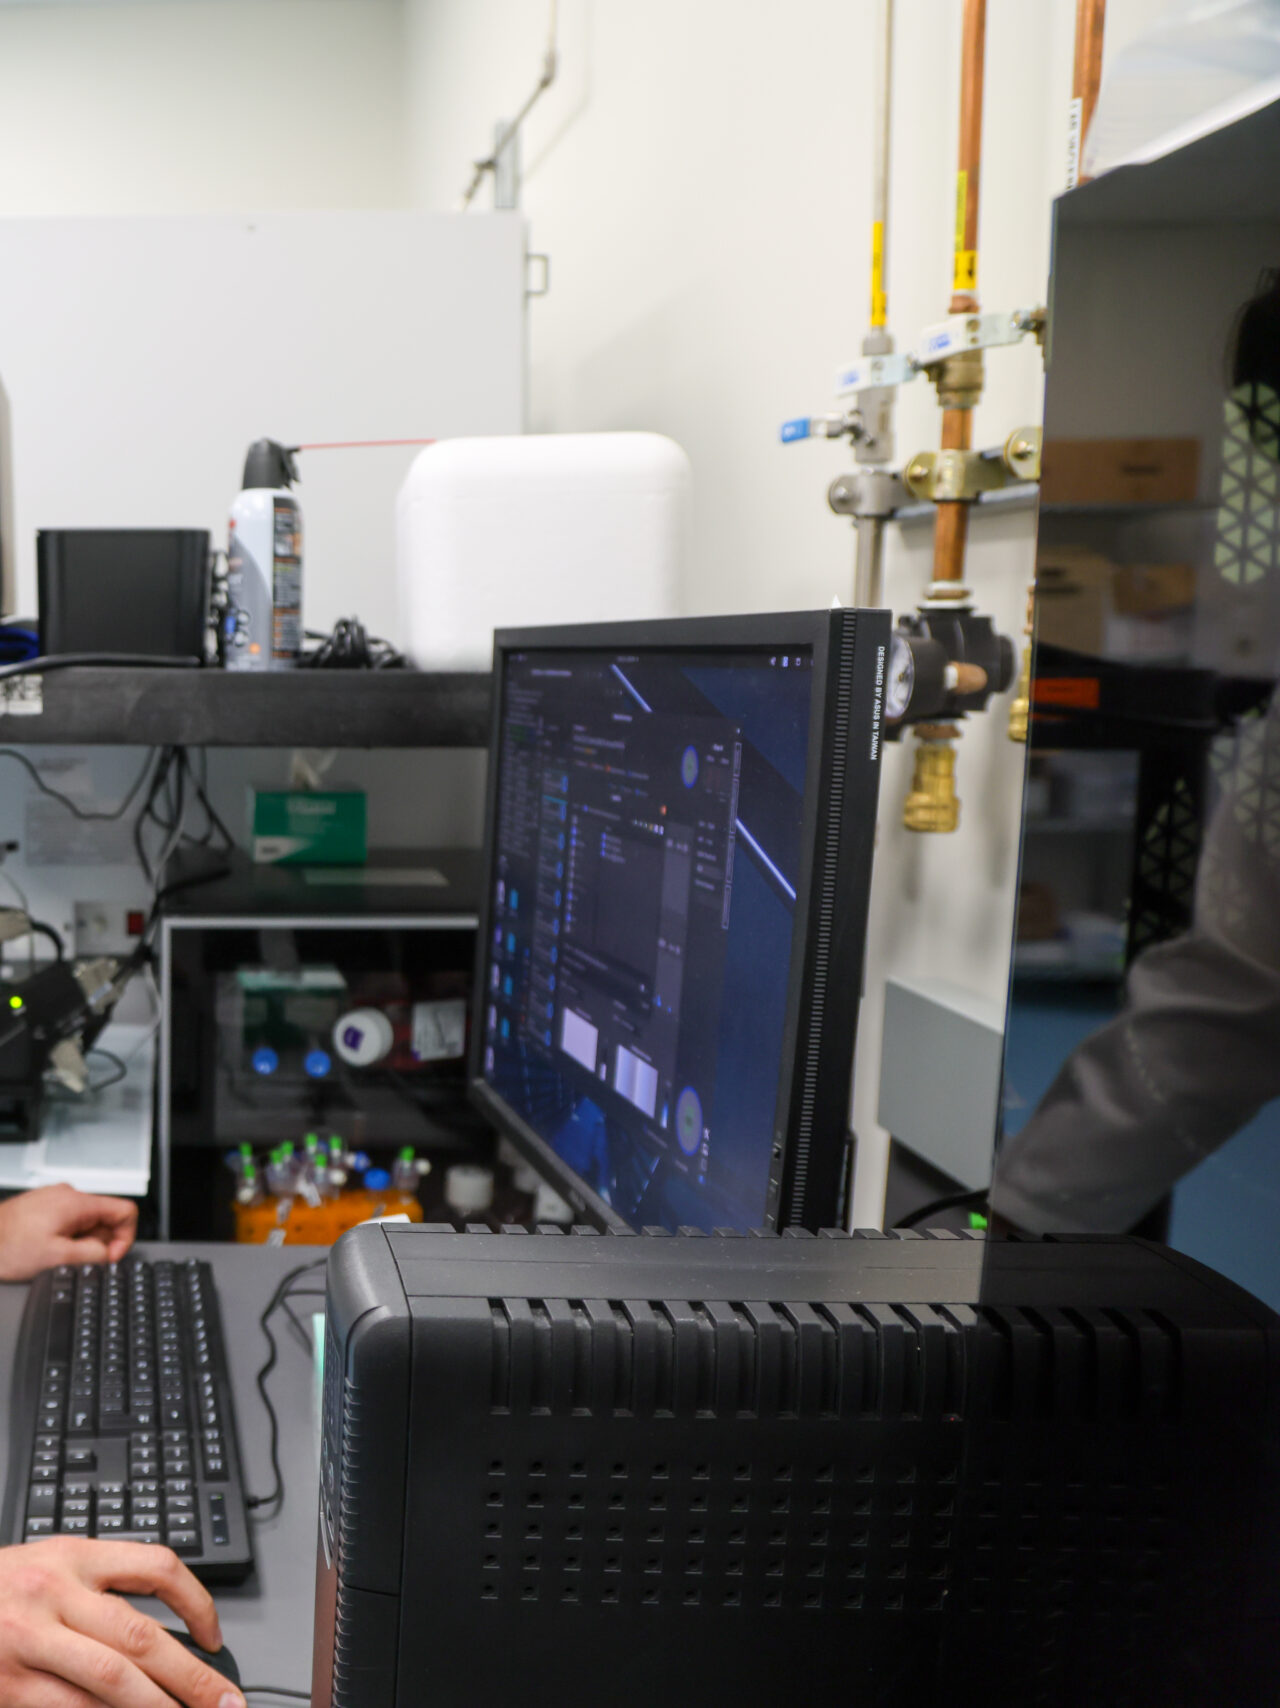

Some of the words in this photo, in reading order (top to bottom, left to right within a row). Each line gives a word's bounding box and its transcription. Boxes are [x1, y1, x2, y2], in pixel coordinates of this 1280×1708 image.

[876, 646, 885, 685] DESIGNED
[875, 687, 882, 697] BY
[873, 699, 882, 720] ASUS
[872, 722, 880, 730] IN
[870, 731, 879, 760] TAIWAN
